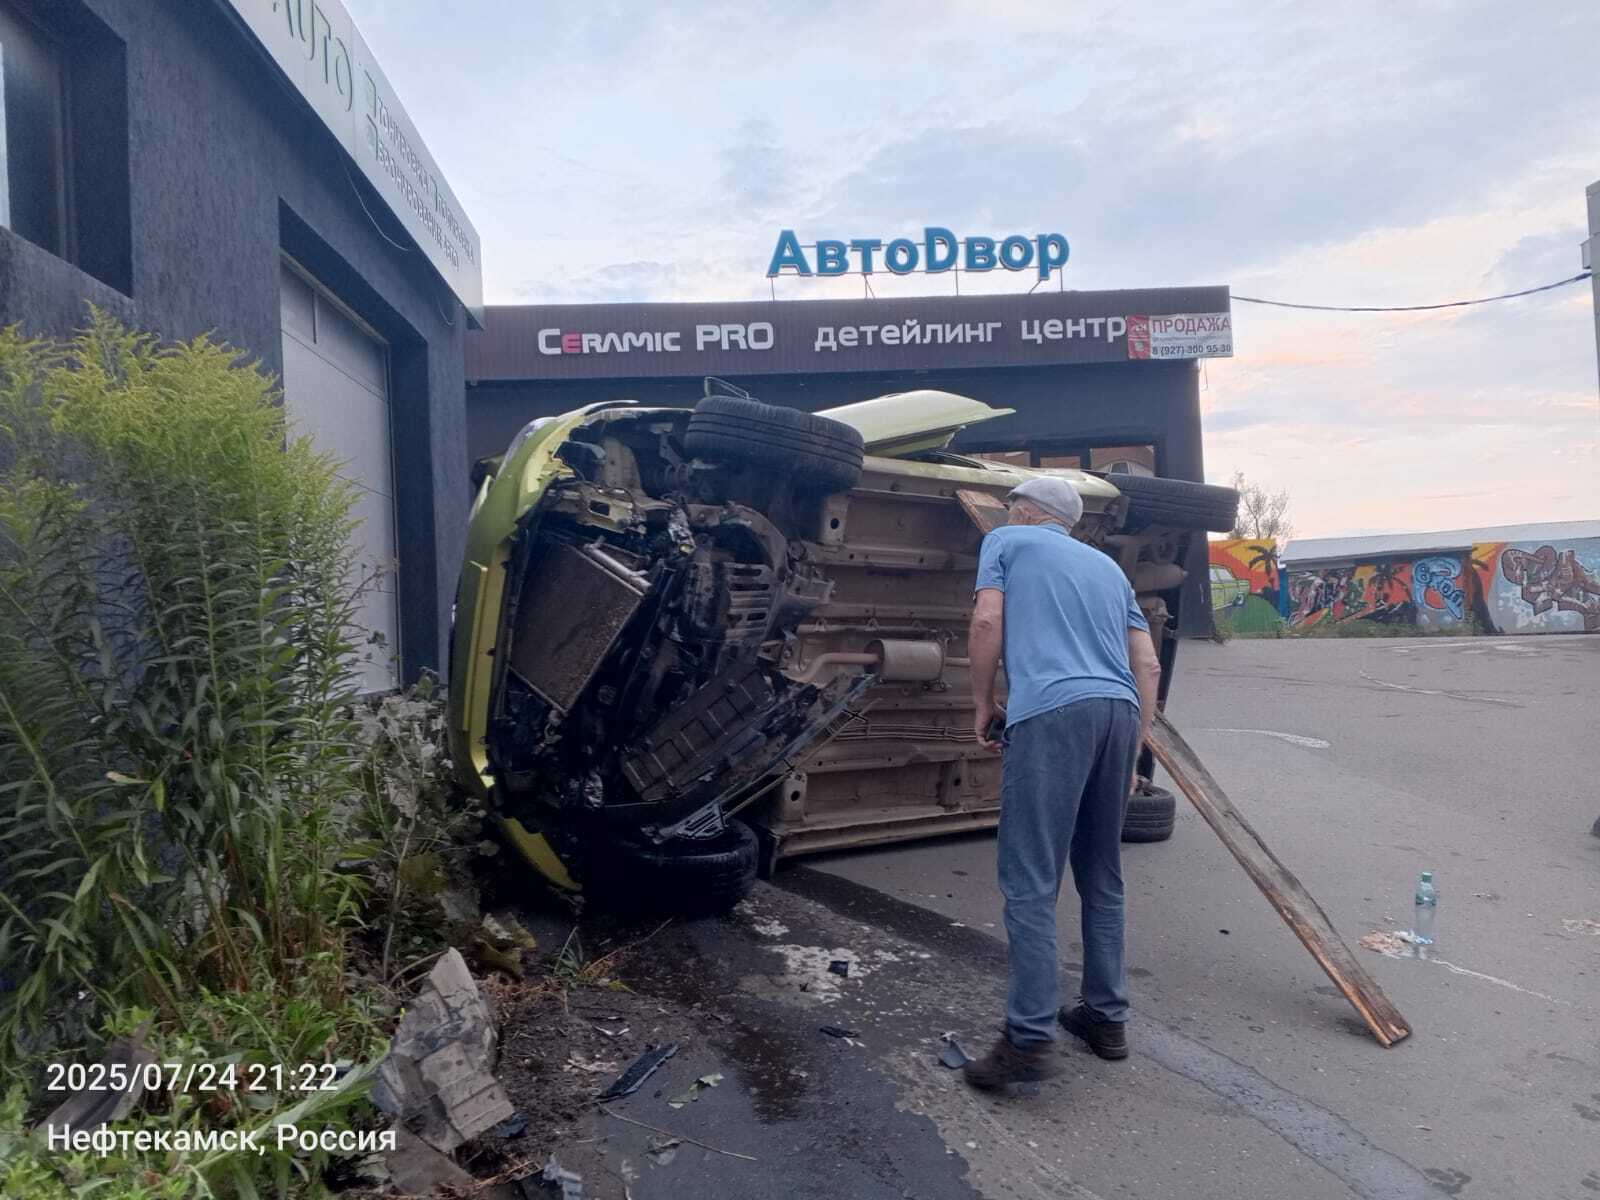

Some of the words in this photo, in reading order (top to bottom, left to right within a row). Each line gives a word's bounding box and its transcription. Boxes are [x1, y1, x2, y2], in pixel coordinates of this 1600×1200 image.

[537, 328, 681, 355] CERAMIC
[696, 322, 775, 351] PRO
[814, 318, 1002, 352] детейлинг
[1021, 315, 1127, 343] центр
[1152, 317, 1231, 336] ПРОДАЖА
[1152, 346, 1159, 355] 8
[1160, 344, 1185, 356] (927)
